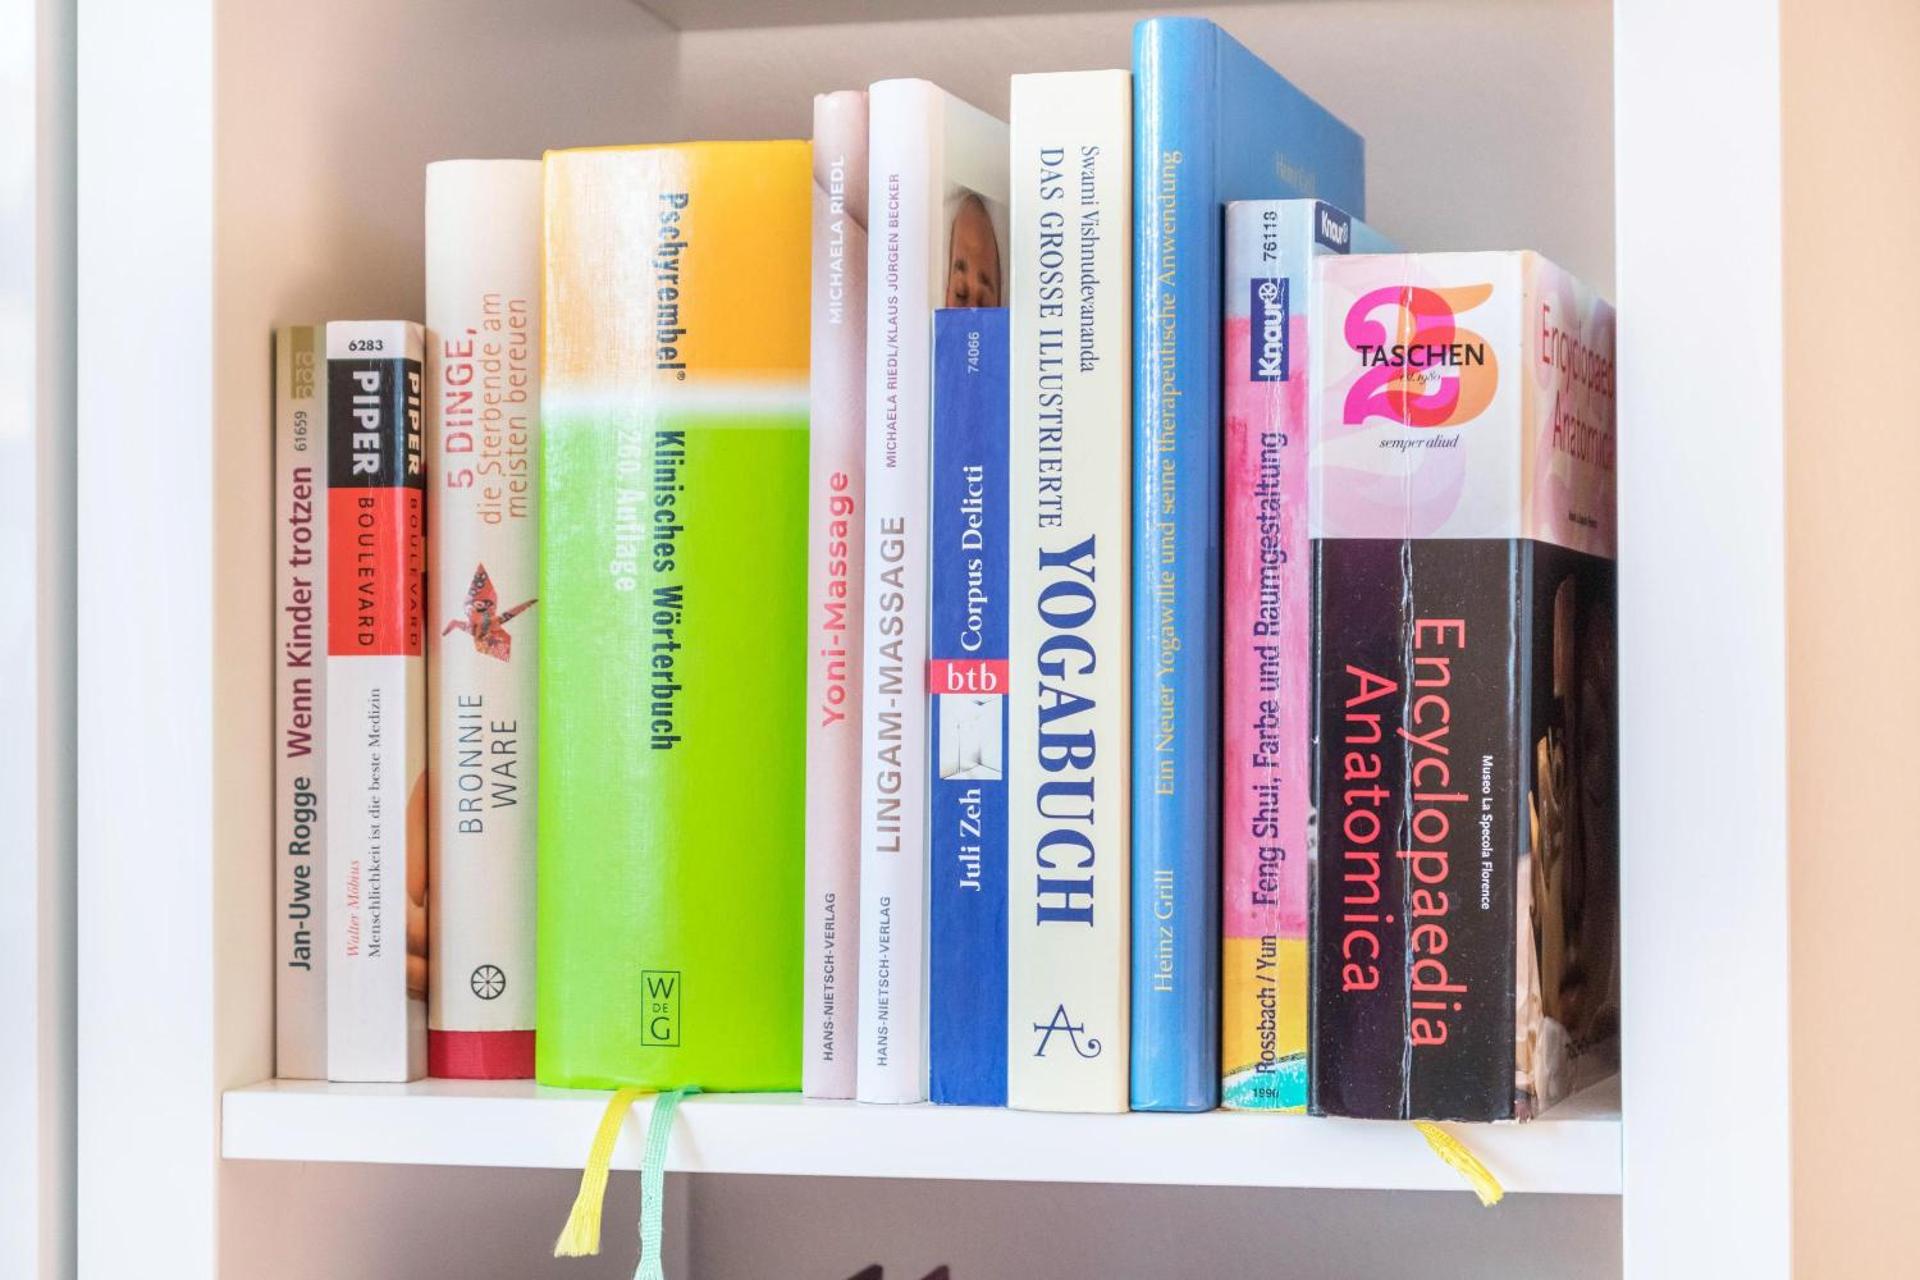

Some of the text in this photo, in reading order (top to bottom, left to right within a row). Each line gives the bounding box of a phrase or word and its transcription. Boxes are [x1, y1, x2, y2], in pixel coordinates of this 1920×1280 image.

[829, 155, 844, 325] MICHAELA RIEDL
[1079, 145, 1100, 373] Swami Vishnudevananda
[1157, 150, 1183, 287] Anwendung
[1262, 211, 1279, 262] 76118
[348, 339, 384, 352] 6283
[886, 173, 900, 468] MICHAELA RIEDL/KLAUS JÜRGEN BECKER
[968, 331, 981, 374] 74066
[1158, 292, 1182, 452] therapeutische
[1258, 300, 1282, 378] Knaur
[1356, 343, 1485, 368] TASCHEN
[294, 410, 307, 452] 61659
[352, 370, 380, 477] PIPER
[407, 371, 421, 476] PIPER
[445, 327, 477, 489] 5 DINGE,
[475, 293, 502, 525] die Sterbende am
[503, 299, 528, 519] meisten bereuen
[1379, 433, 1460, 453] semper aliud
[608, 488, 647, 592] Auflage
[1036, 147, 1097, 928] DAS GROSSE ILLUSTRIERTE YOGABUCH
[1157, 522, 1176, 564] und
[1160, 458, 1176, 514] seine
[286, 466, 312, 759] Wenn Kinder trotzen
[357, 497, 375, 647] BOULEVARD
[650, 430, 685, 751] Klinisches Wörterbuch
[821, 471, 854, 728] Yoni-Massage
[960, 464, 988, 652] Corpus Delicti
[876, 515, 905, 853] LINGAM-MASSAGE
[946, 662, 998, 692] btb
[1154, 686, 1175, 753] Neuer
[1251, 432, 1288, 906] Feng Shui, Farbe und Raumgestaltung
[368, 688, 381, 958] Menschlichkeit ist die beste Medizin
[458, 694, 484, 835] BRONNIE
[491, 720, 517, 809] WARE
[1154, 759, 1174, 796] Ein
[1341, 664, 1399, 993] Anatomica
[1395, 617, 1469, 1047] Encyclopaedia
[1479, 754, 1494, 910] Museo La Specola Florence
[288, 776, 317, 971] Jan-Uwe Rogge
[958, 787, 982, 892] Juli Zeh
[646, 976, 675, 999] W
[823, 892, 836, 1061] HANS-NIETSCH-VERLAG
[877, 895, 891, 1067] HANS-NIETSCH-VERLAG
[1153, 869, 1174, 993] Heinz Grill
[1256, 934, 1277, 969] Yun
[651, 1016, 670, 1041] G
[652, 1003, 669, 1013] DE
[1254, 986, 1277, 1075] Rossbach
